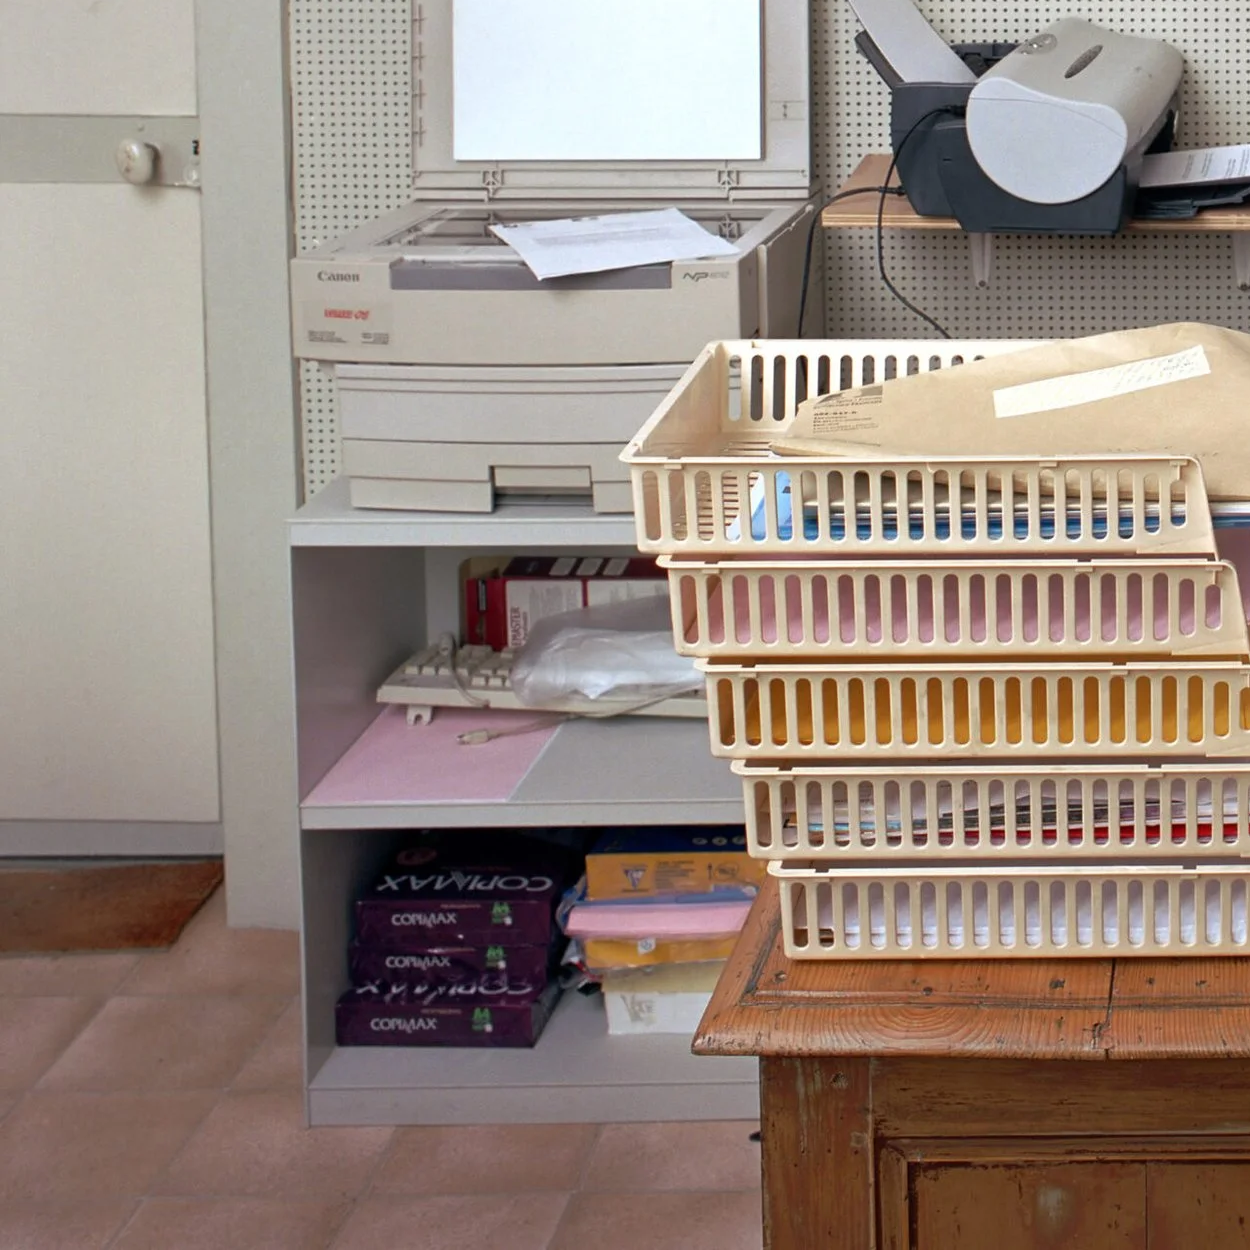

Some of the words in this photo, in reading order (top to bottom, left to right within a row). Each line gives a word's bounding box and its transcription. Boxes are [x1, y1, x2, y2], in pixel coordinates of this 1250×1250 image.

[317, 270, 360, 282] Canon
[391, 913, 457, 928] COPIMAX
[385, 955, 450, 971] COPIMAX
[370, 1017, 438, 1034] COPIMAX
